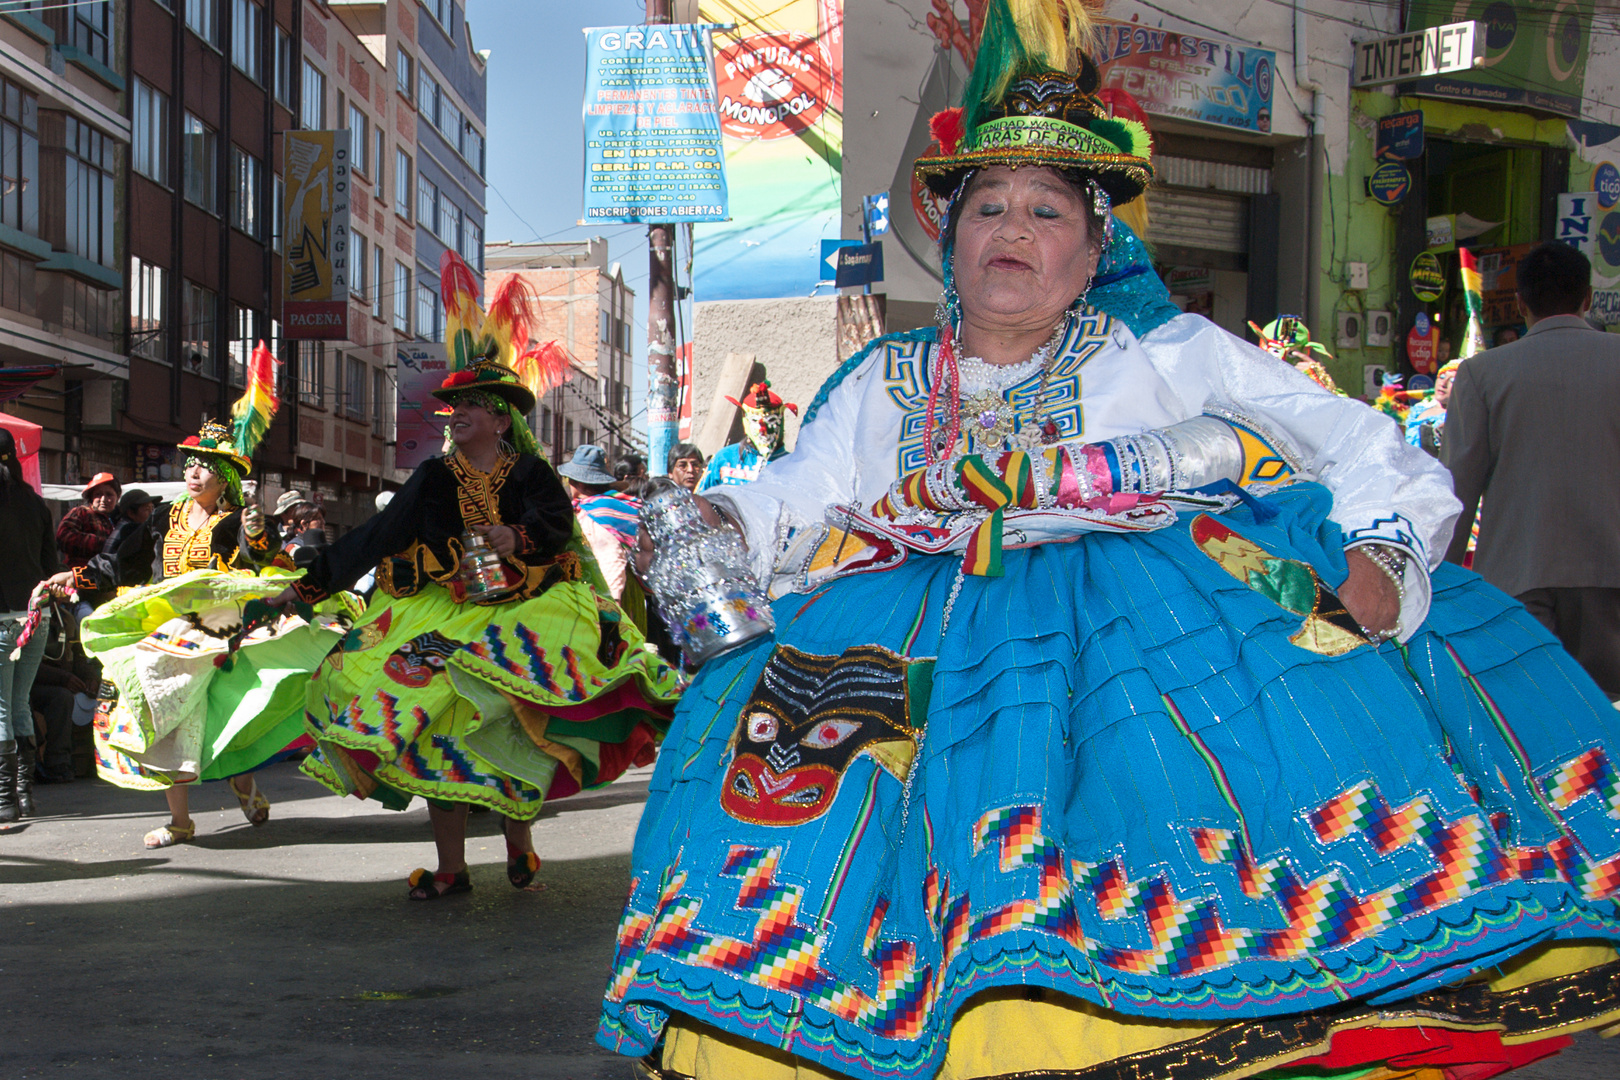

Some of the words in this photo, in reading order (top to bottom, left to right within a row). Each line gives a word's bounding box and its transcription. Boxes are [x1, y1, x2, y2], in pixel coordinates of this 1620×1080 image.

[599, 30, 699, 51] GRATI
[1092, 23, 1167, 66] NEW
[601, 57, 643, 65] CORTES
[1360, 27, 1467, 81] INTERNET
[724, 46, 814, 80] PINTURAS
[609, 67, 660, 75] VARONES
[598, 89, 677, 101] PERMANENTES
[681, 88, 713, 99] TINTE
[1104, 66, 1249, 114] FERNANDO
[1434, 83, 1460, 94] Centro
[1461, 87, 1471, 95] de
[587, 103, 644, 115] LIMPIEZAS
[647, 103, 655, 114] Y
[719, 91, 816, 126] MONOPOL
[636, 117, 651, 128] DE
[654, 116, 678, 127] PIEL
[1206, 113, 1223, 123] and
[1227, 116, 1251, 127] KIDS
[1380, 113, 1419, 130] recarga
[1028, 130, 1051, 144] DE
[603, 149, 625, 158] EN
[629, 147, 717, 158] INSTITUTO
[591, 162, 651, 172] BERLIN
[655, 161, 690, 170] R.M.
[589, 206, 668, 217] INSCRIPCIONES
[671, 205, 723, 216] ABIERTAS
[290, 310, 342, 326] PACEÑA
